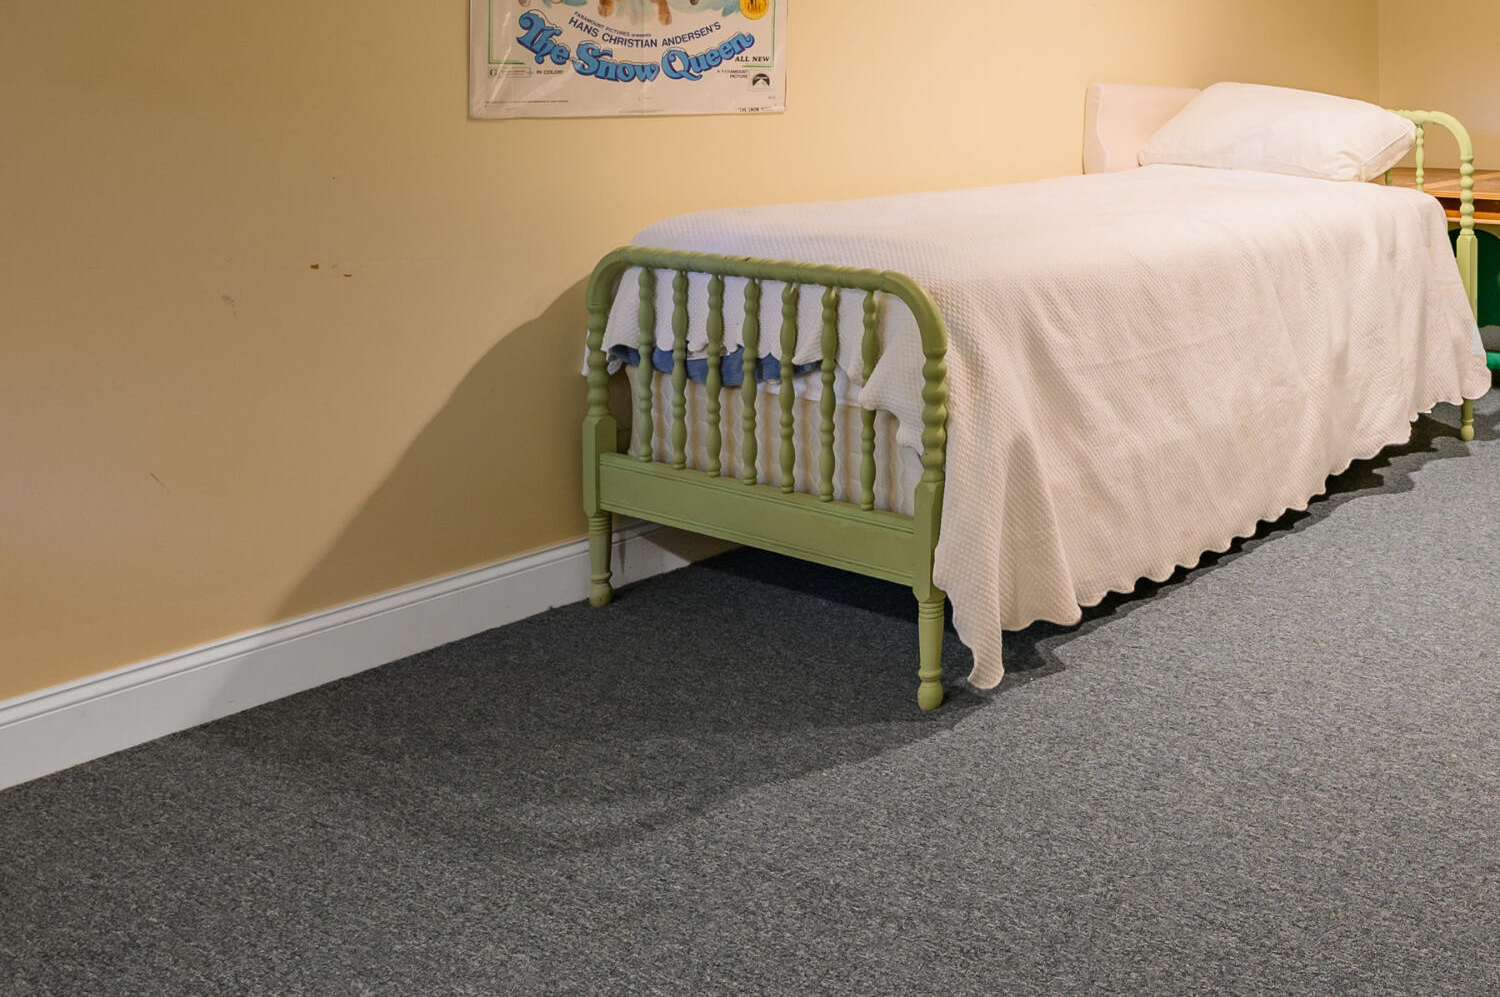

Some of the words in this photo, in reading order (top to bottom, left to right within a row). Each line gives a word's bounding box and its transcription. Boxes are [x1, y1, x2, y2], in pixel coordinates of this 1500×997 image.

[568, 16, 599, 37] HANS
[602, 33, 658, 47] CHRISTIAN
[662, 21, 721, 47] ANDERSEN'S
[574, 11, 604, 29] PARAMOUNT
[605, 27, 630, 37] PICTURES
[516, 9, 571, 65] The
[571, 40, 660, 82] Snow
[661, 31, 755, 81] Queen
